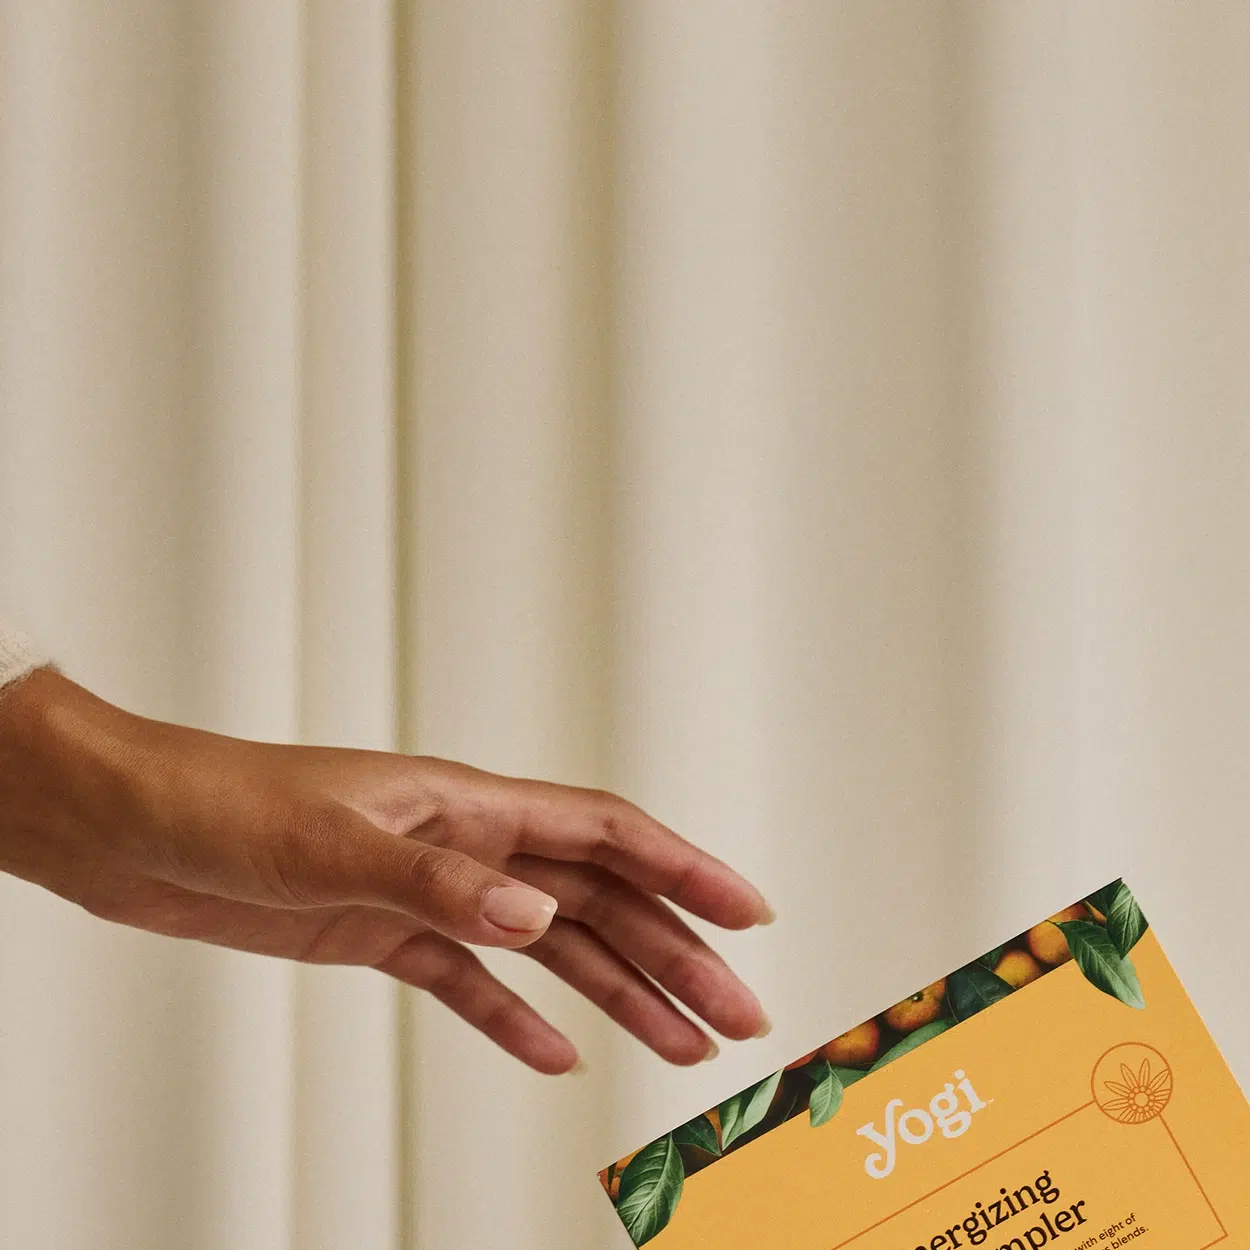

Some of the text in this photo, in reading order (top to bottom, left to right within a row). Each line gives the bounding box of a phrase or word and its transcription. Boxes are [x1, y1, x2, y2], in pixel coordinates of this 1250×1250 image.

[855, 1069, 987, 1180] yogi
[1098, 1222, 1125, 1241] eight
[1125, 1212, 1136, 1225] of
[1110, 1226, 1149, 1250] blends.
